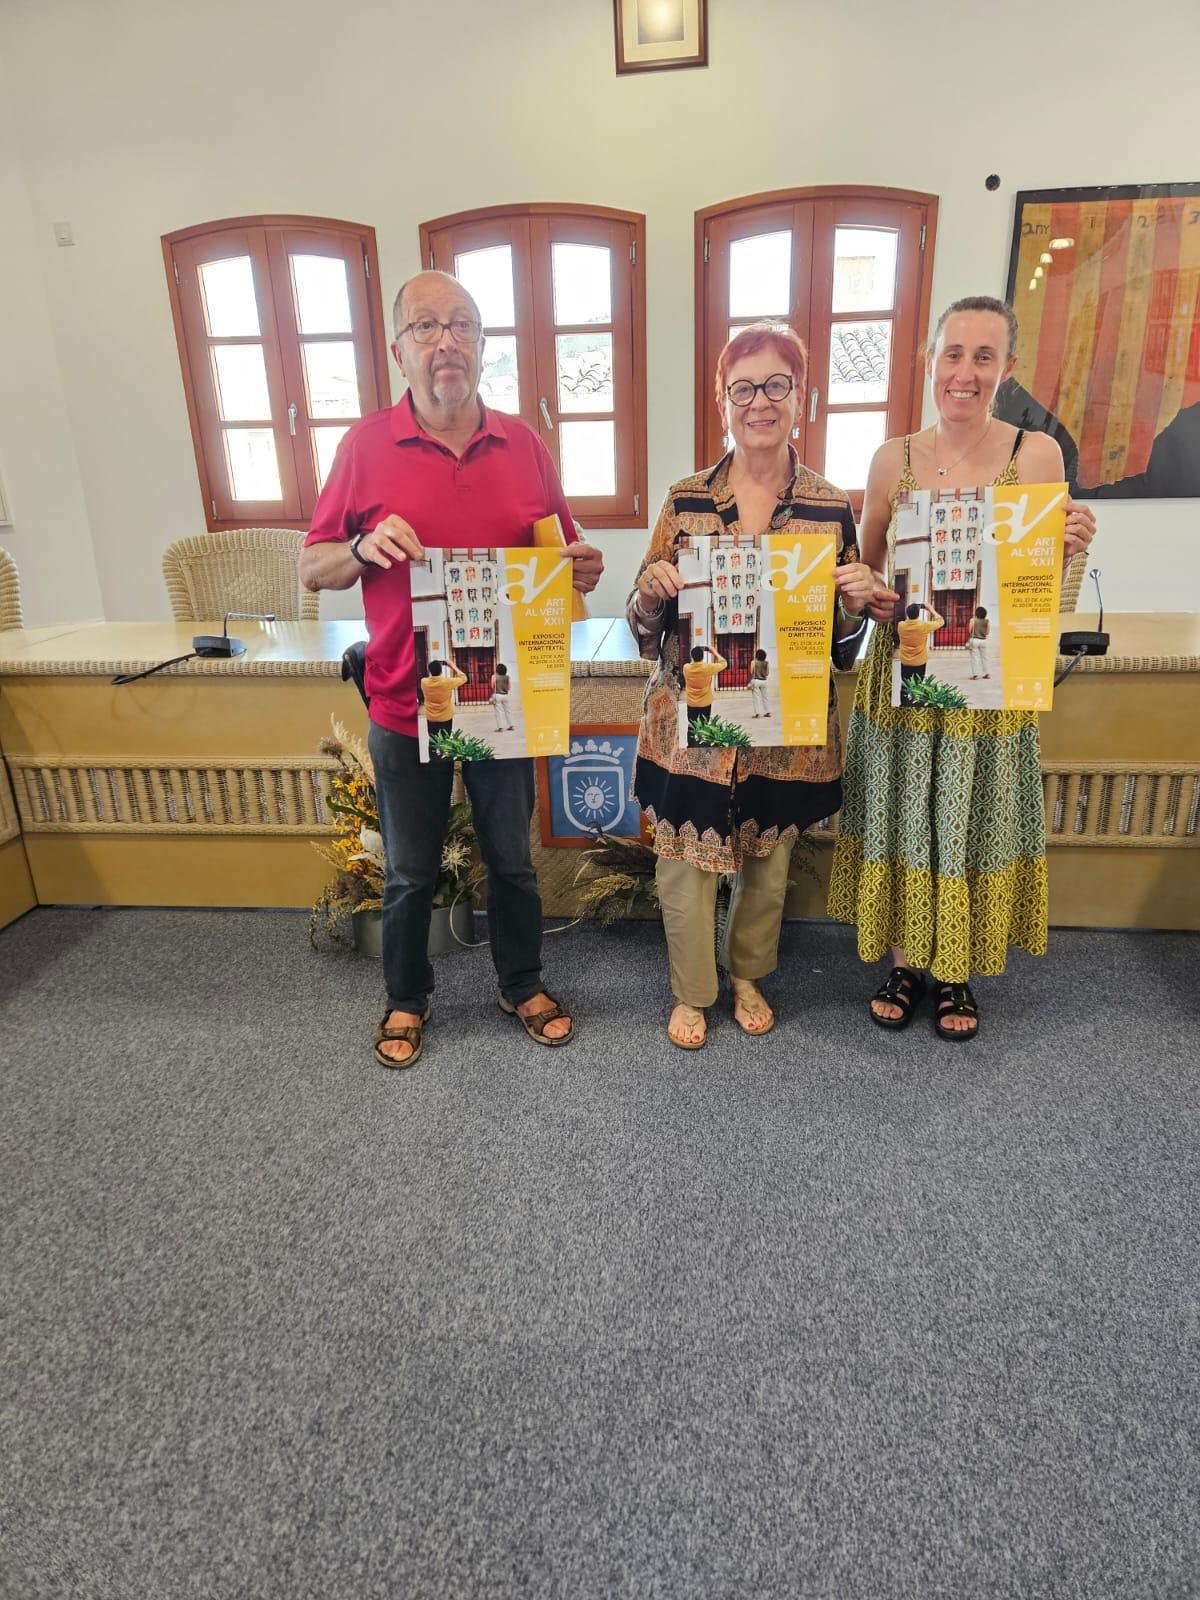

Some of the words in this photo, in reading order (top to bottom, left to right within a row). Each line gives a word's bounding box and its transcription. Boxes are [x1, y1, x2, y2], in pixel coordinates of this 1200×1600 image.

[1035, 537, 1056, 546] ART
[1011, 548, 1024, 557] AL
[1027, 547, 1056, 556] VENT
[1031, 558, 1055, 567] XXII
[808, 585, 828, 593] ART
[546, 598, 565, 607] ART
[787, 595, 800, 604] AL
[802, 594, 828, 602] VENT
[525, 608, 538, 617] AL
[540, 607, 565, 616] VENT
[806, 603, 827, 612] XXII
[544, 617, 565, 626] XXII
[518, 639, 565, 647] INTERNACIONAL
